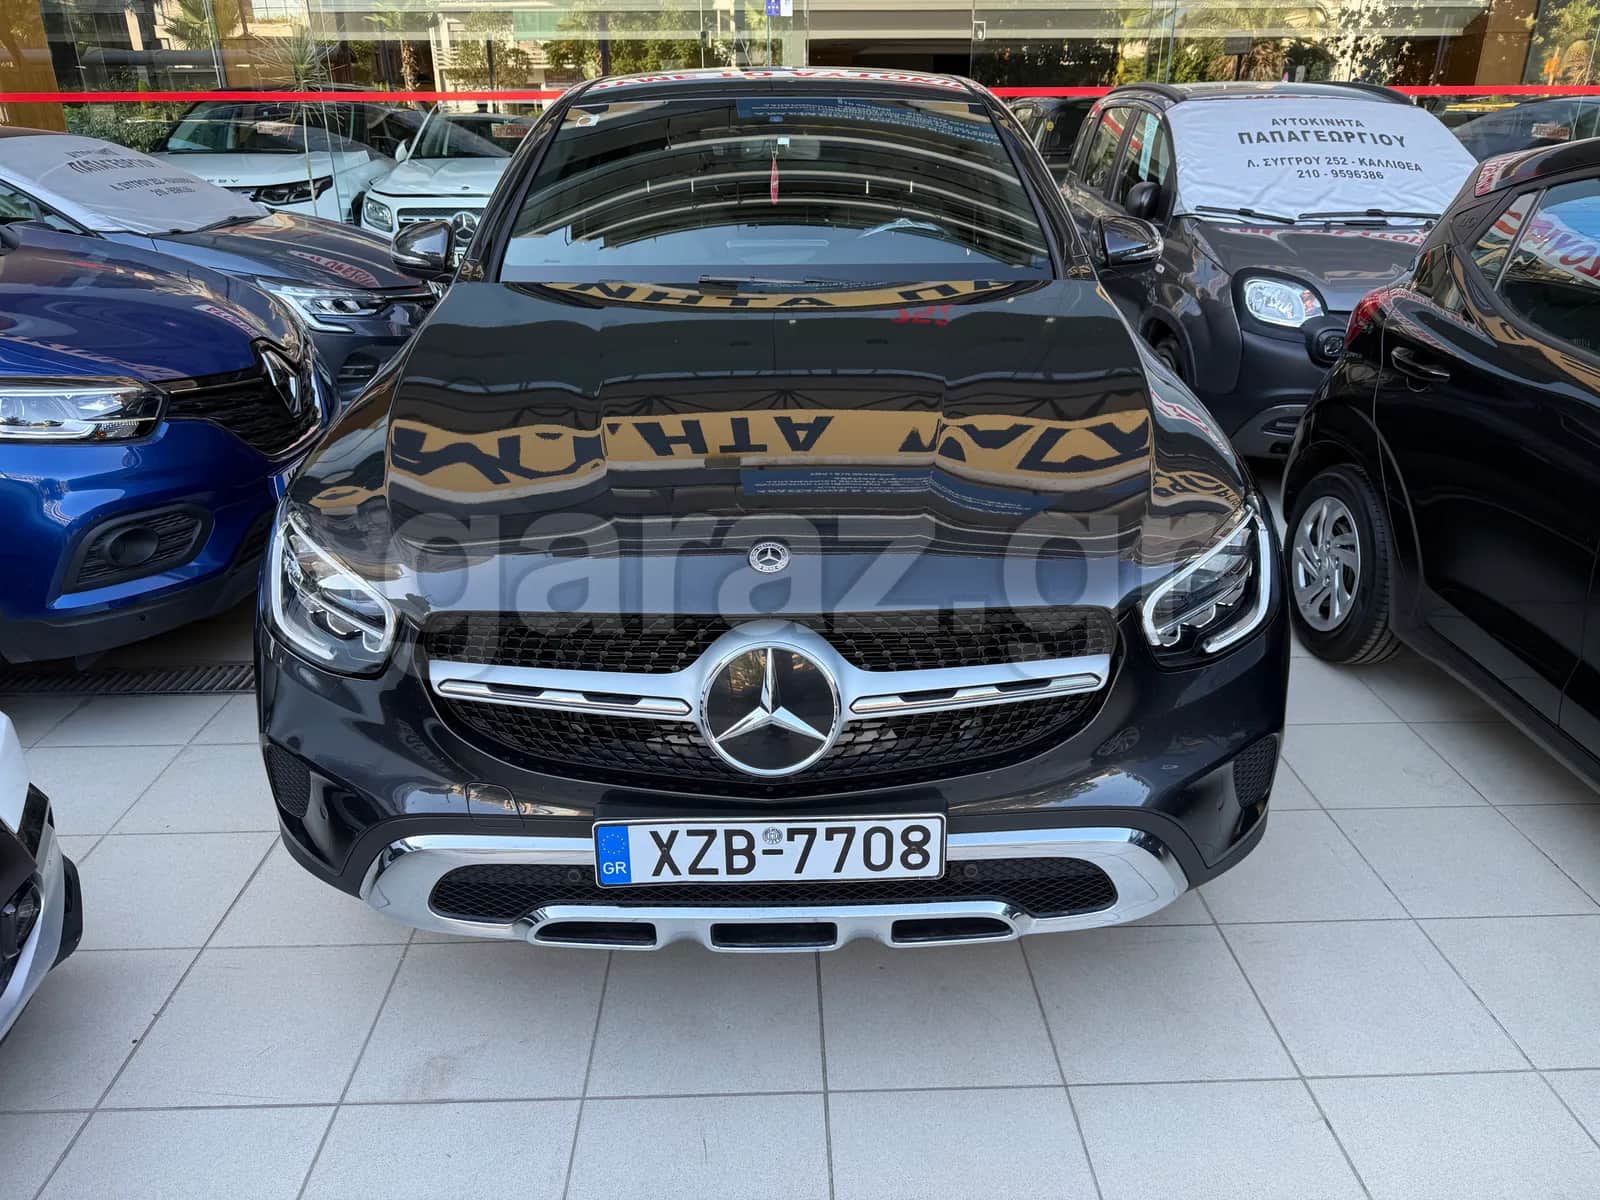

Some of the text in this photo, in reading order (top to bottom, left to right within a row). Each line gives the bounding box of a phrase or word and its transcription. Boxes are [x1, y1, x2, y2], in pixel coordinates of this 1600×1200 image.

[1271, 117, 1365, 128] ΑΥΤΟΚΙΝΗΤΑ
[1237, 130, 1406, 148] ΠΑΠΑΓΕΩΡΓΙΟΥ
[1264, 156, 1321, 167] ΣΥΓΓΡΟΥ
[1325, 156, 1349, 166] 252
[1358, 157, 1422, 172] ΚΑΛΛΙΘΕΑ
[1296, 169, 1320, 179] 210
[1331, 169, 1384, 180] 9596386
[649, 824, 932, 877] XZB-7708
[603, 861, 627, 875] GR
